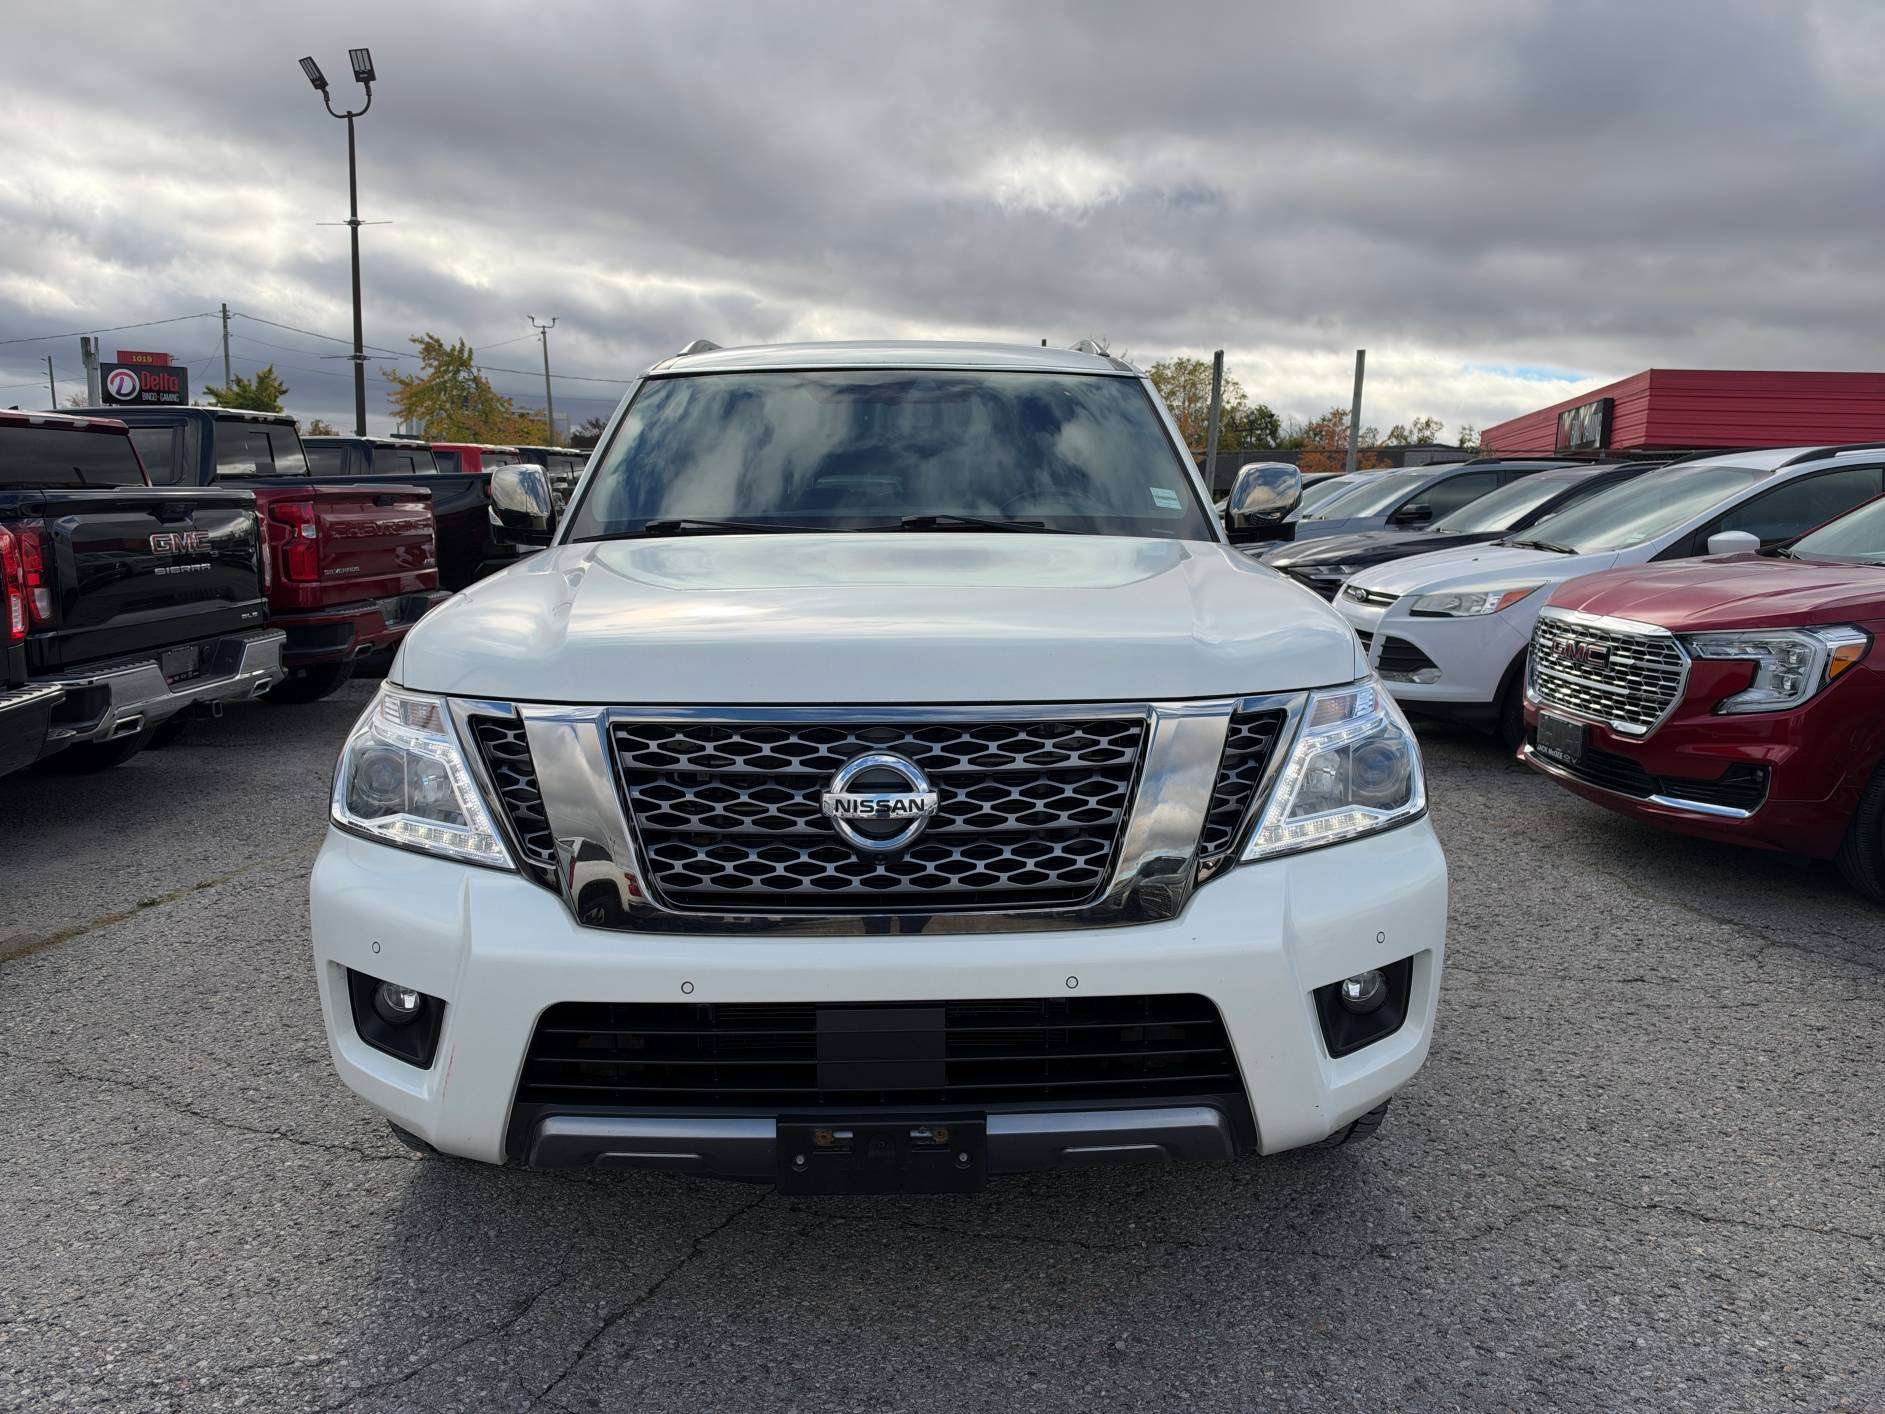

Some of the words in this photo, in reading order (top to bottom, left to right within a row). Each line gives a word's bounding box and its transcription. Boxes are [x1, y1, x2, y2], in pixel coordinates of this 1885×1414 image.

[141, 371, 179, 392] Delta
[149, 530, 210, 556] GMC
[154, 563, 211, 575] SIERRA
[1551, 638, 1611, 671] GMC
[835, 799, 925, 814] NISSAN
